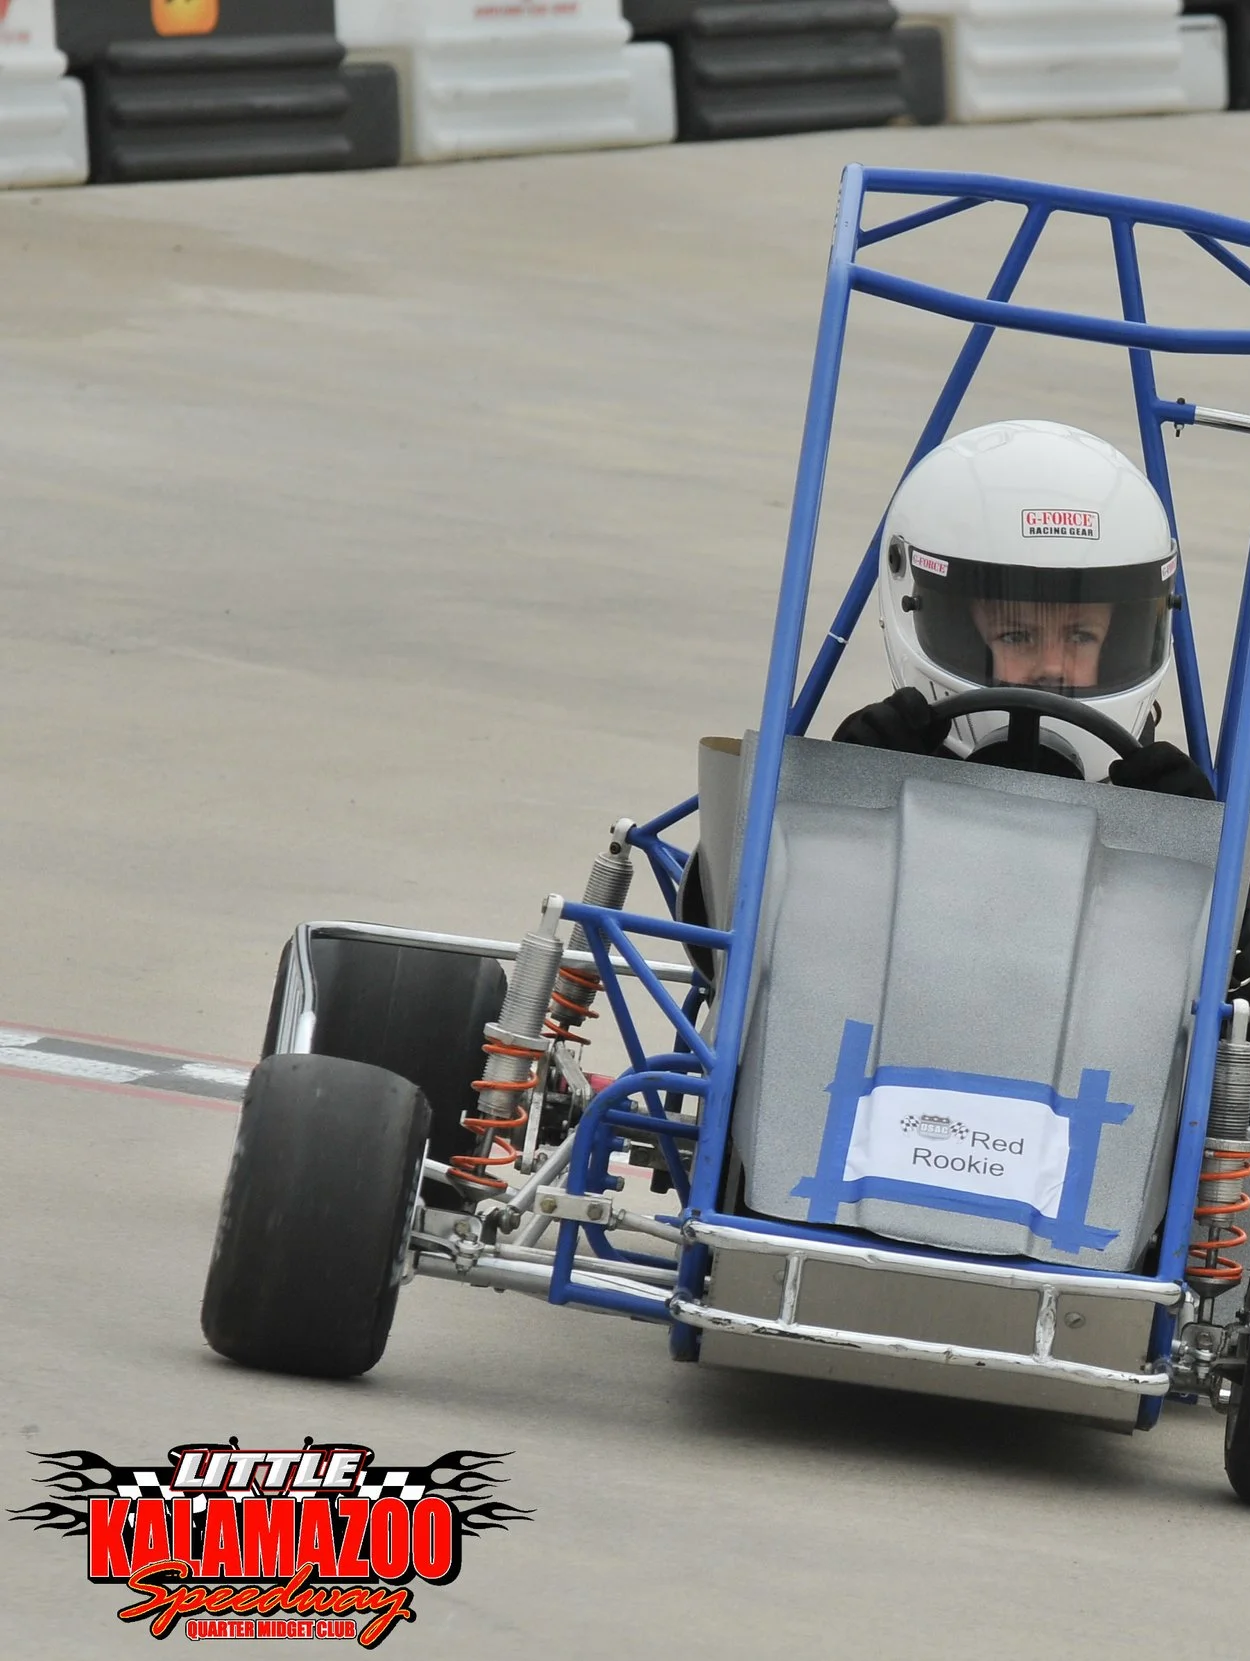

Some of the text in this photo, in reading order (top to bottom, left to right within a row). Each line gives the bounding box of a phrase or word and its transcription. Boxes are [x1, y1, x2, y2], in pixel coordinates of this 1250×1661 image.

[1026, 511, 1093, 527] G-FORCE
[1029, 527, 1094, 536] RACING GEAR
[971, 1131, 1025, 1155] Red
[912, 1147, 1005, 1177] Rookie
